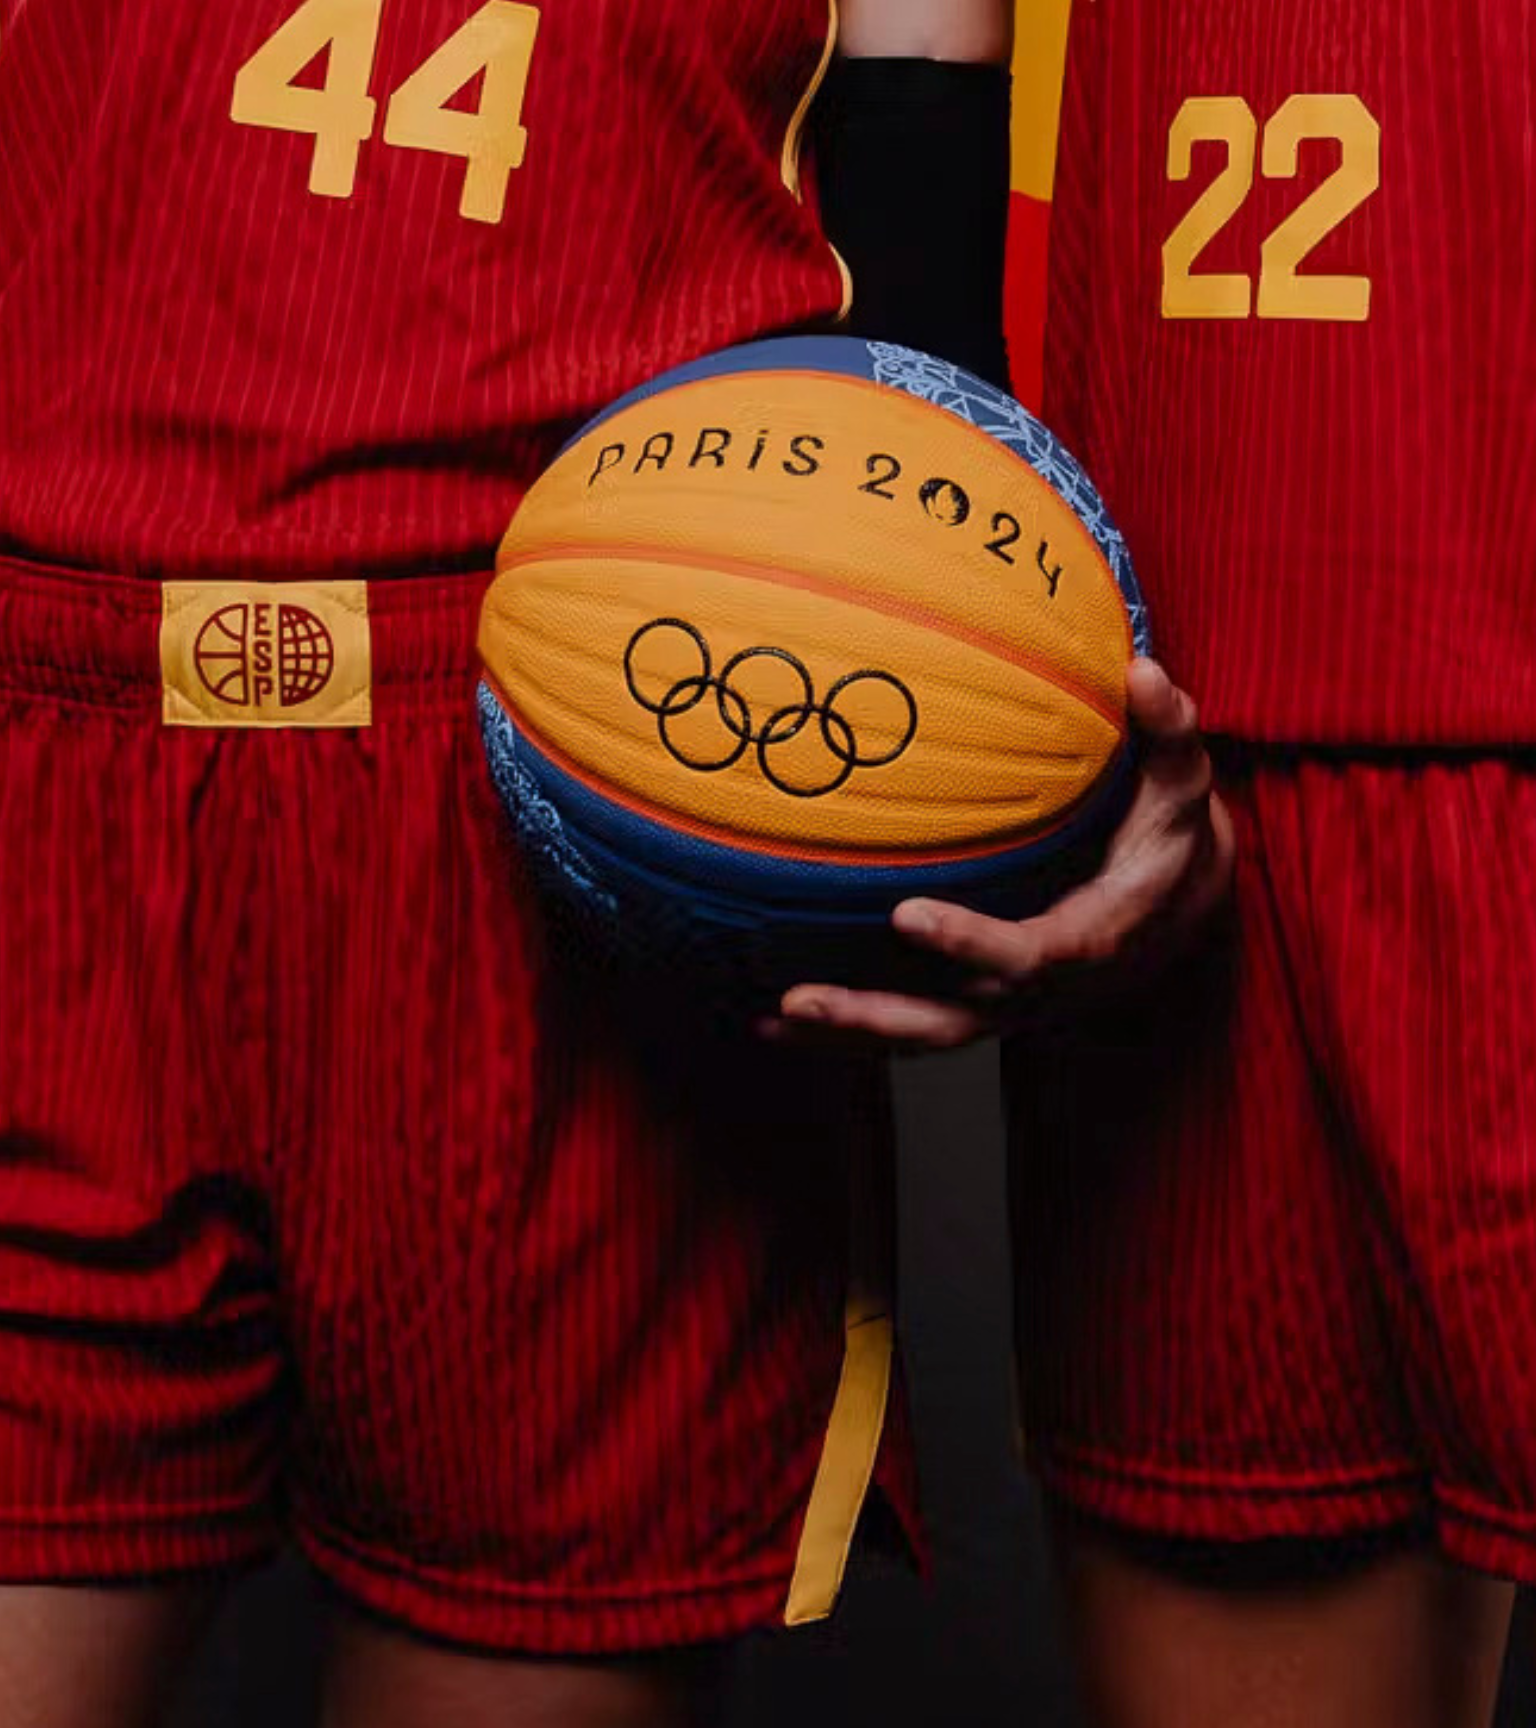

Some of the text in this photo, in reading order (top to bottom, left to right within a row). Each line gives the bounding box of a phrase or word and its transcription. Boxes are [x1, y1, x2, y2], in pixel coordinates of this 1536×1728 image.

[1161, 94, 1380, 322] 22
[857, 452, 1065, 598] 2024
[253, 603, 275, 707] ESP
